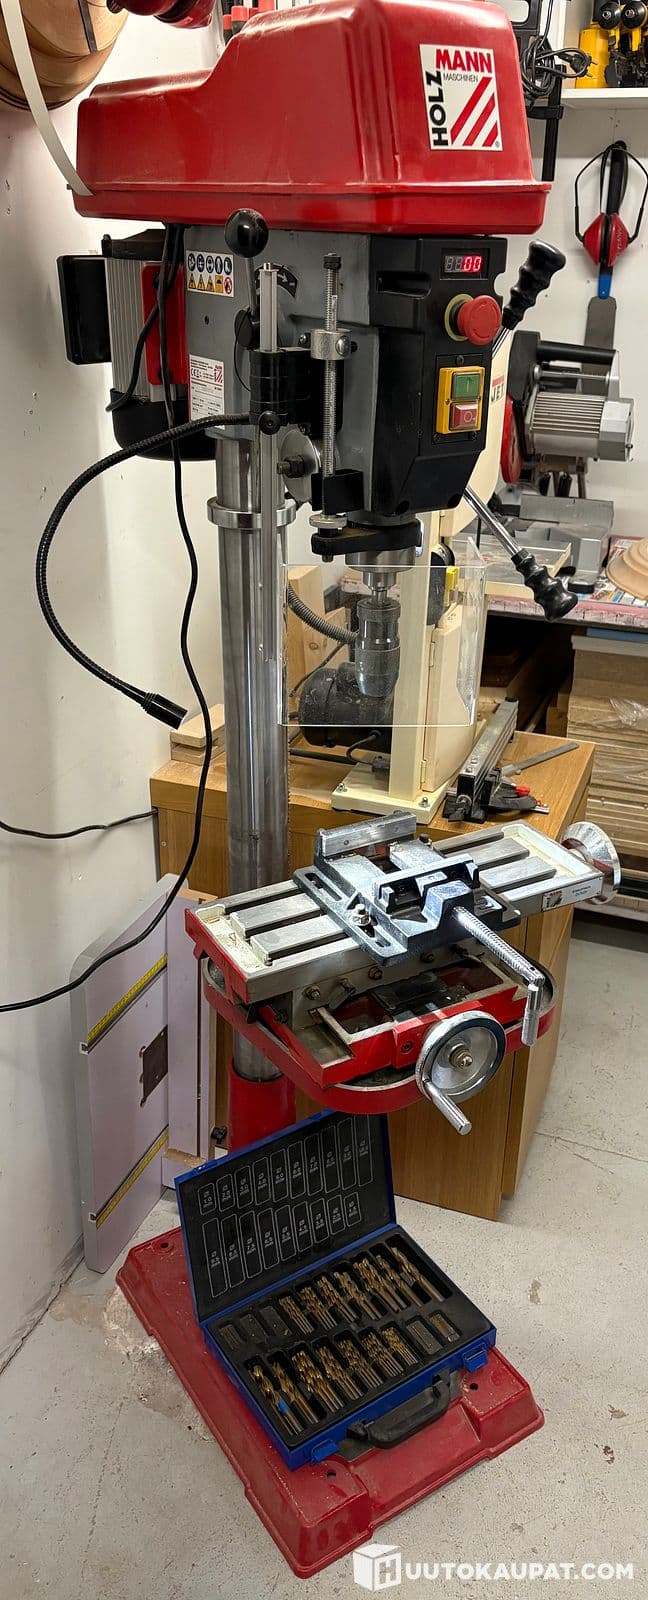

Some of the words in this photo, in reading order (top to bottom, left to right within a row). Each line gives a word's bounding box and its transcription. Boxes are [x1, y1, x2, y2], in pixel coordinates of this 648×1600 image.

[436, 49, 492, 73] MANN
[443, 73, 478, 82] MASCHINEN
[425, 71, 448, 146] HOLZ
